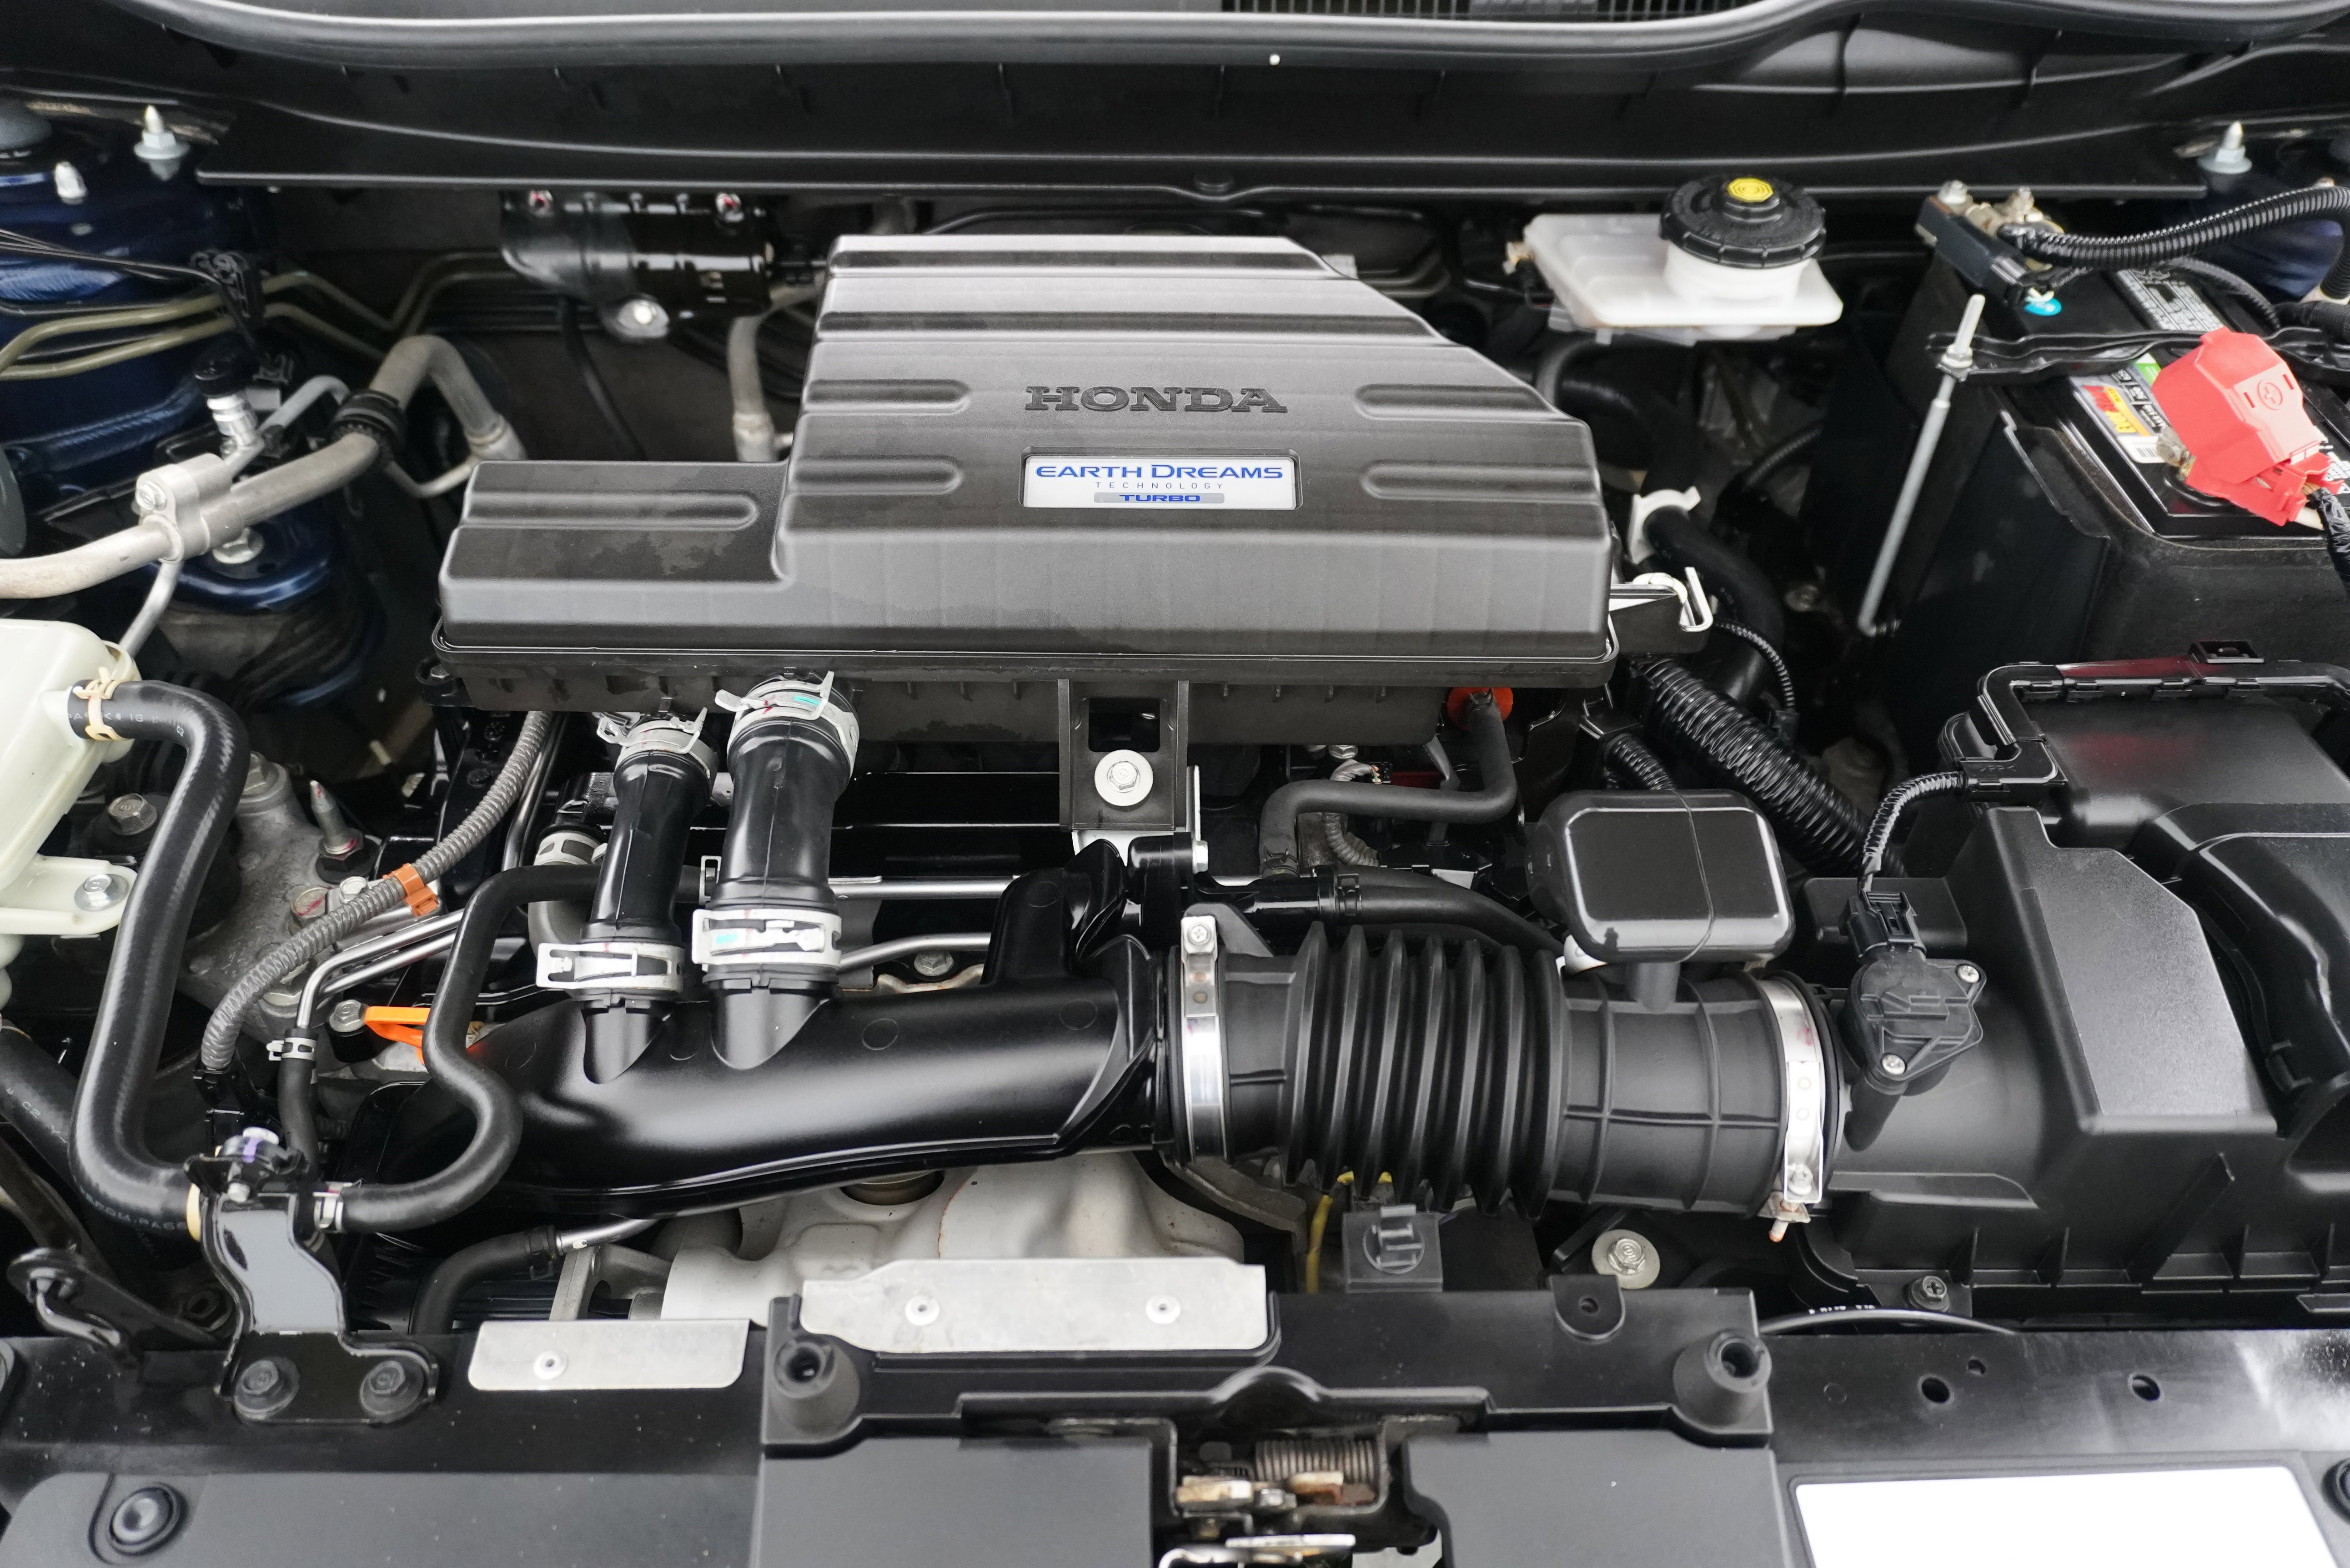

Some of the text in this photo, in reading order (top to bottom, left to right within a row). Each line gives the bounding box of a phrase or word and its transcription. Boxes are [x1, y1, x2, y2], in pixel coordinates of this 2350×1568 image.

[1024, 386, 1288, 413] HONDA
[1036, 464, 1283, 479] EARTH DREAMS
